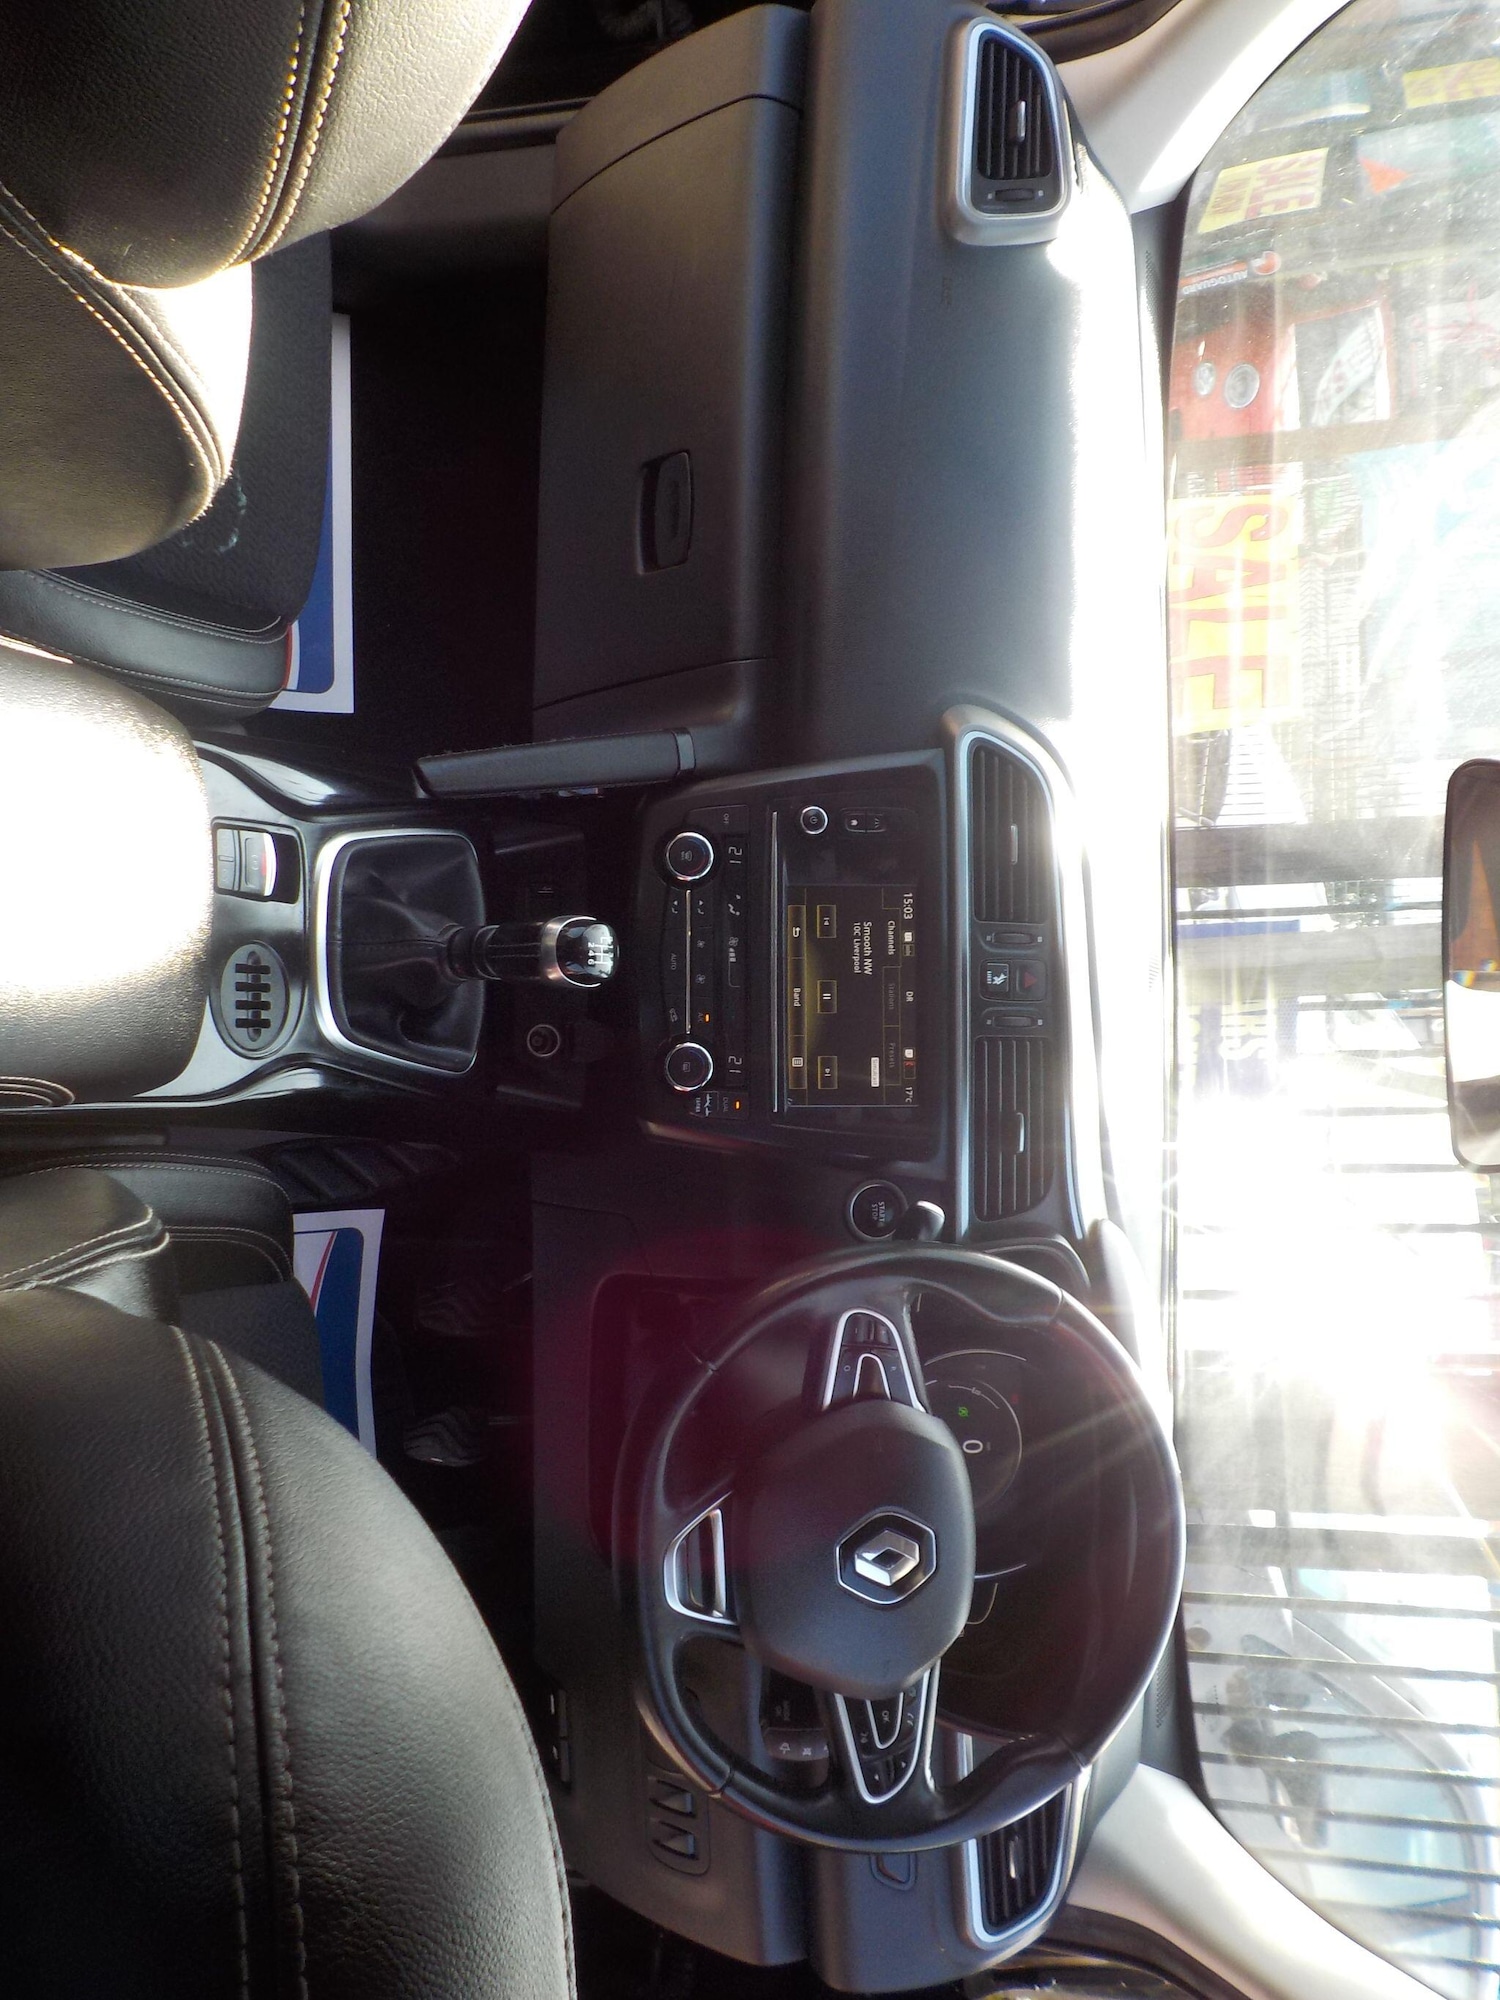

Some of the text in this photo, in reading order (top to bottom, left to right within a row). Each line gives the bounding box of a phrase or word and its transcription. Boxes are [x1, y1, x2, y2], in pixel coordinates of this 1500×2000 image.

[1244, 155, 1322, 219] SALE
[1182, 270, 1248, 294] AUTOGUARD
[1168, 504, 1289, 720] SALE
[722, 813, 730, 825] OFF
[728, 846, 742, 864] 21
[903, 892, 913, 920] 15:03
[851, 921, 862, 974] 10C Liverpool
[863, 921, 872, 976] Smooth NW
[887, 920, 896, 956] Channels
[792, 988, 802, 1007] Band
[888, 983, 896, 1010] Stations
[906, 991, 913, 1002] DR
[728, 1056, 742, 1074] 21
[888, 1042, 896, 1069] Presets
[962, 1440, 983, 1454] 0
[882, 1710, 890, 1724] OK
